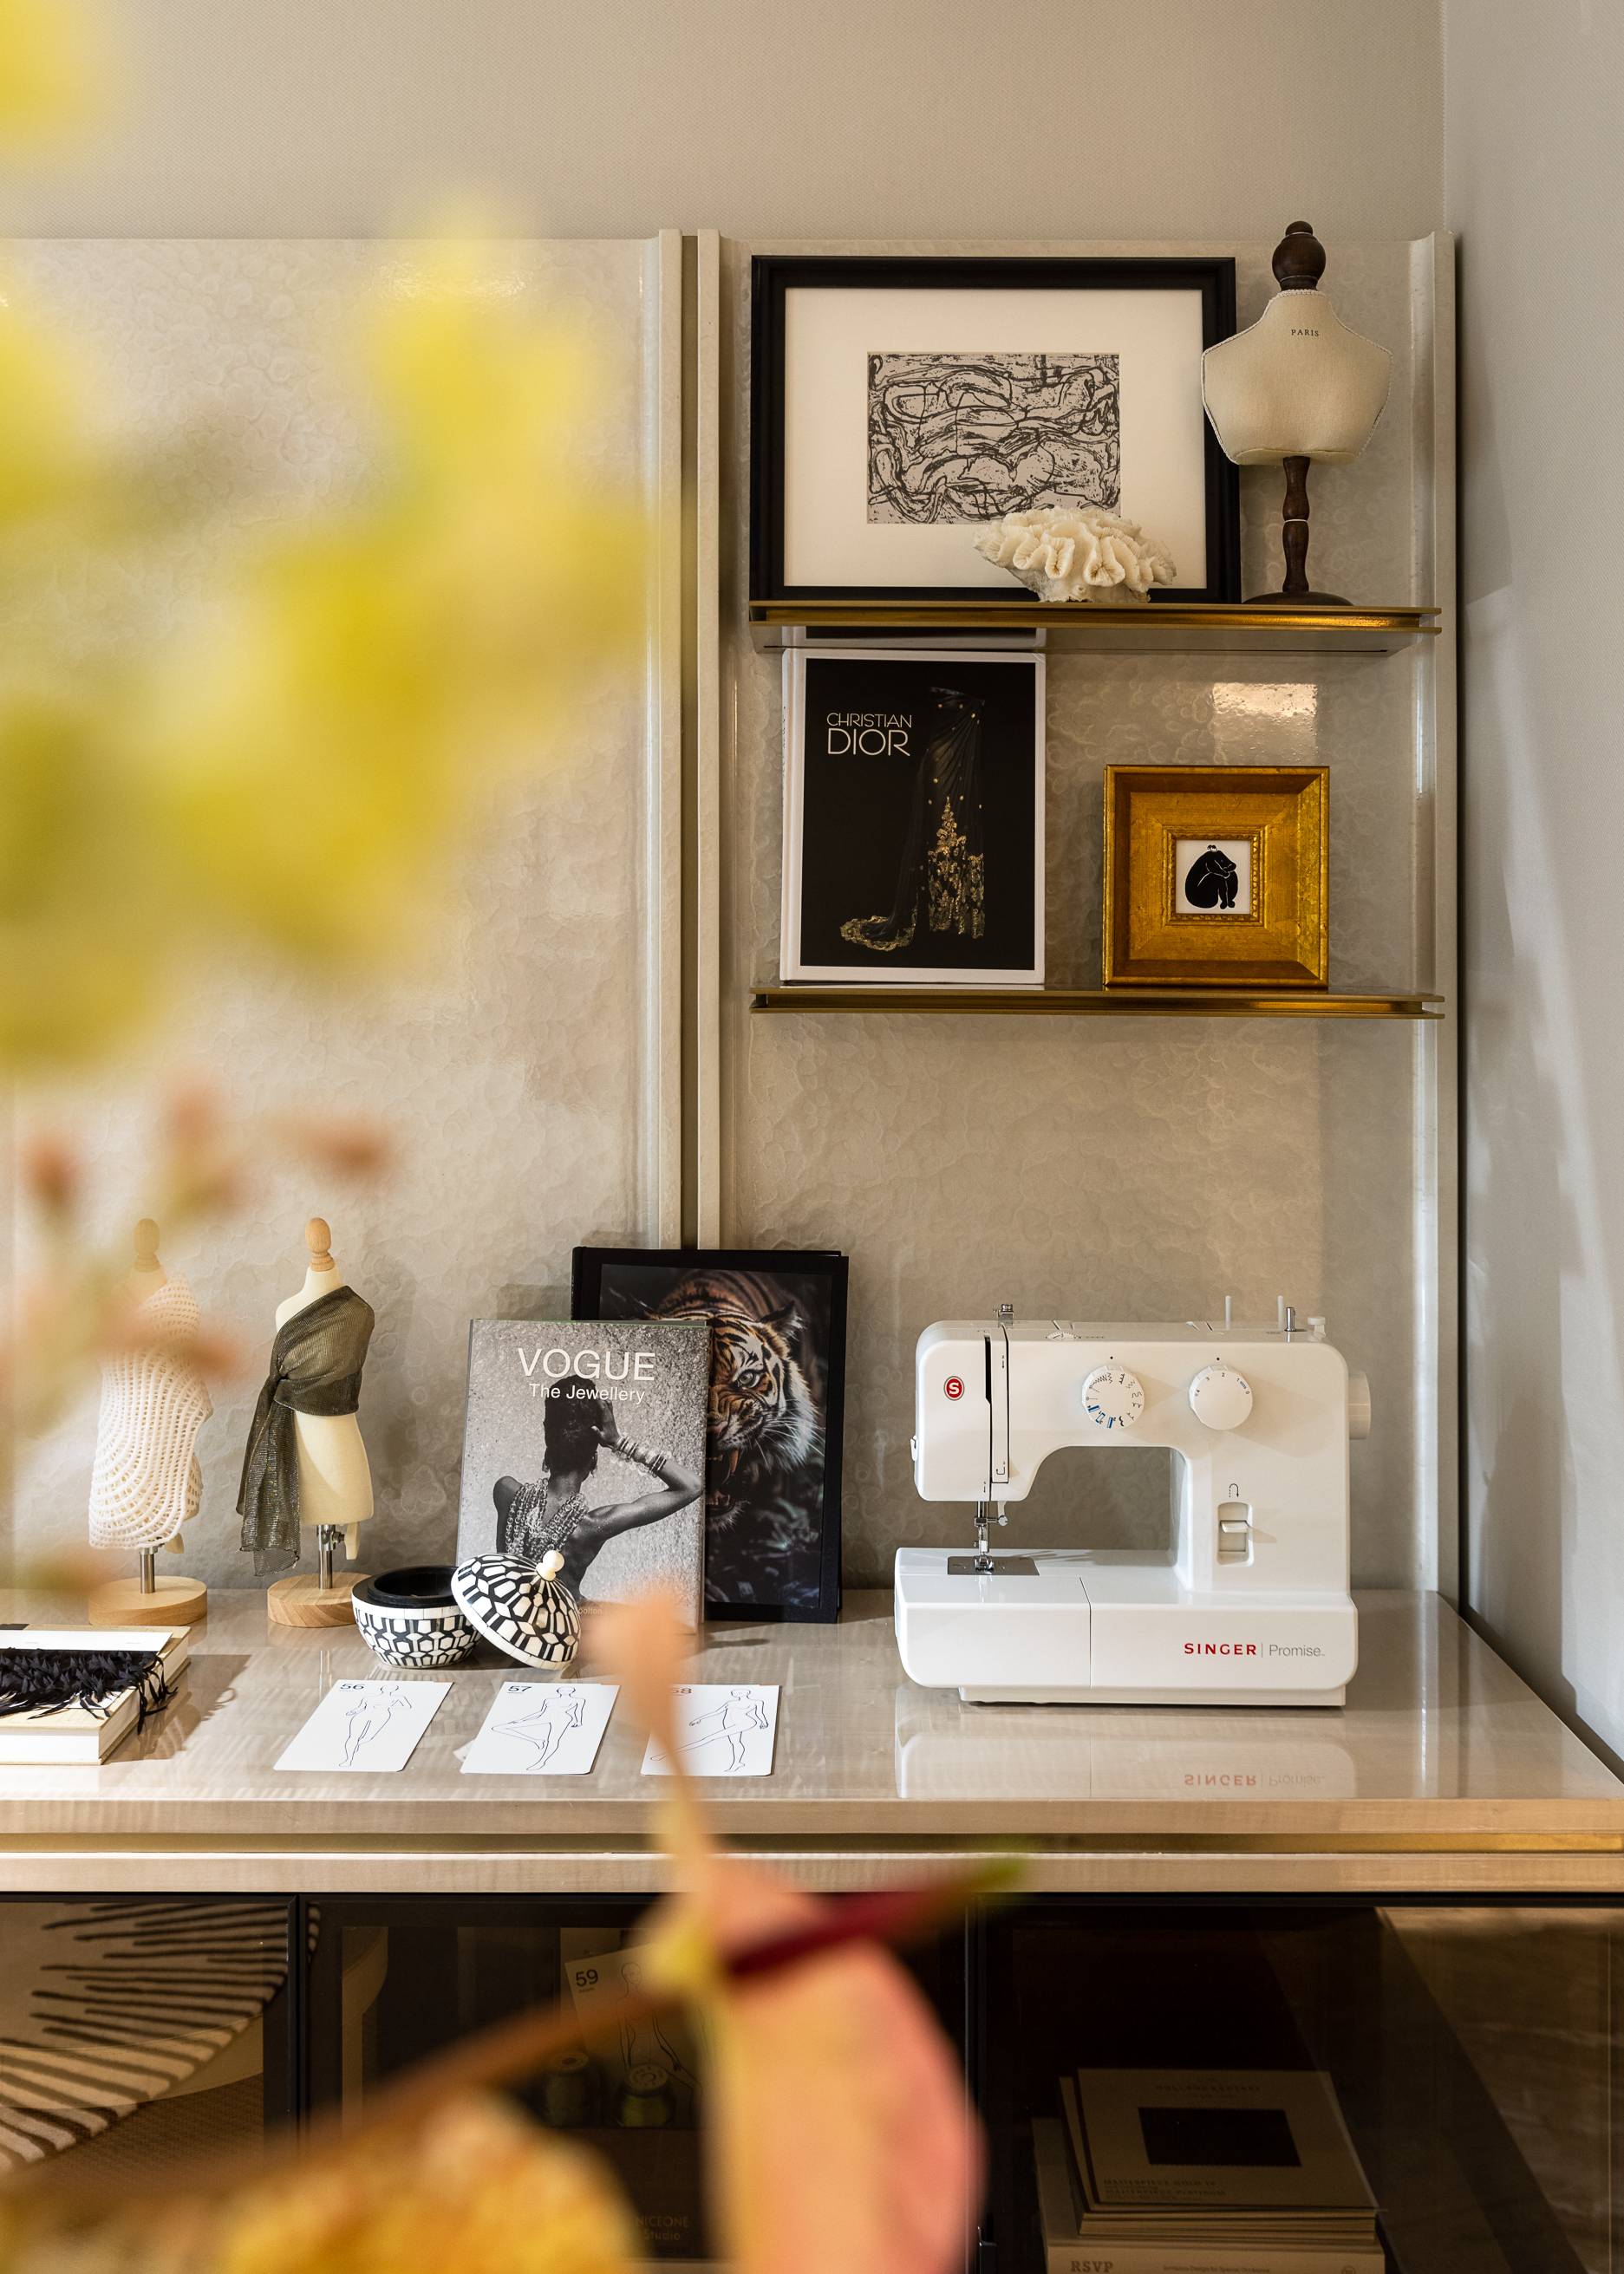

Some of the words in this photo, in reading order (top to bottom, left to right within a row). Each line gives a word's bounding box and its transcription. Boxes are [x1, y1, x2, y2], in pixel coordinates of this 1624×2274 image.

[1291, 329, 1320, 337] PARIS
[826, 712, 912, 728] CHRISTIAN
[827, 727, 911, 757] DIOR
[518, 1347, 655, 1381] VOGUE
[529, 1383, 561, 1398] The
[565, 1385, 645, 1405] Jewellery
[577, 1606, 603, 1615] oolton
[1184, 1643, 1257, 1656] SINGER
[576, 1969, 598, 1987] 59
[644, 2227, 682, 2240] Studio
[1070, 2259, 1114, 2273] RSVP
